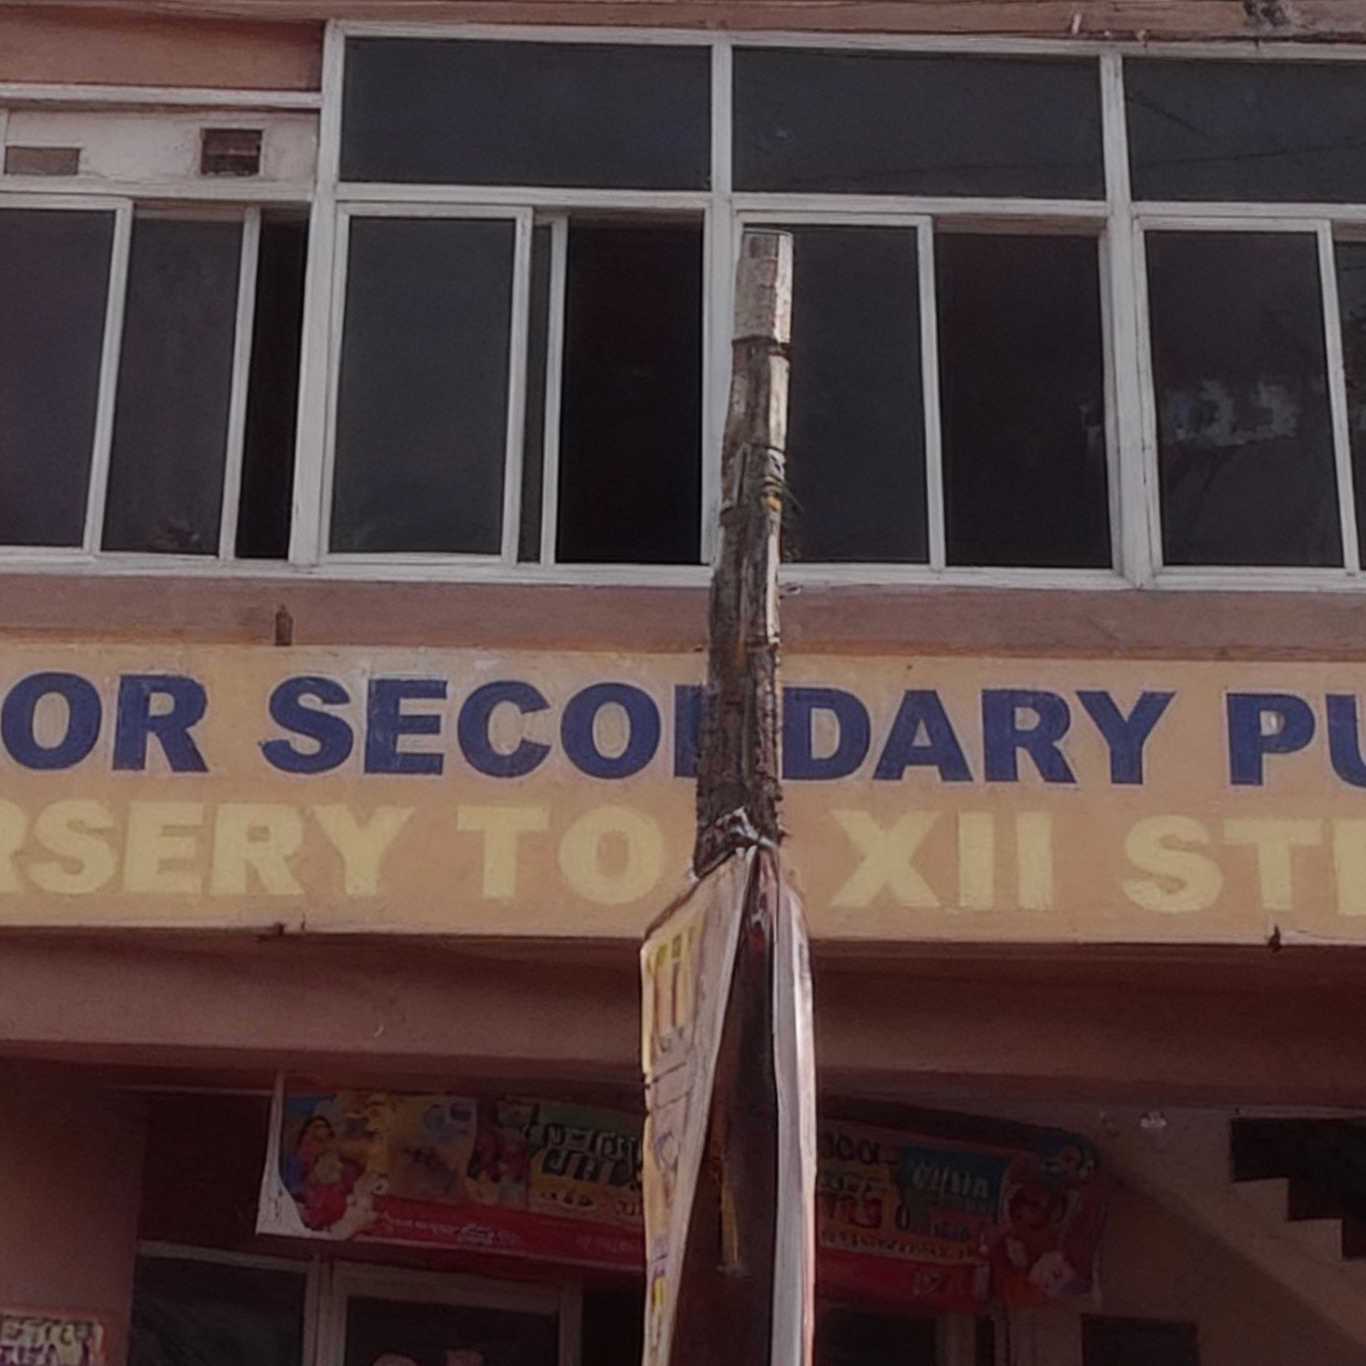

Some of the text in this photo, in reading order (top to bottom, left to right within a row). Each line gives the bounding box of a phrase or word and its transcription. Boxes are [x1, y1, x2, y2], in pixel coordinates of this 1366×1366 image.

[261, 675, 1175, 785] SECODARY
[457, 803, 665, 905] TO
[829, 810, 1055, 912] XII
